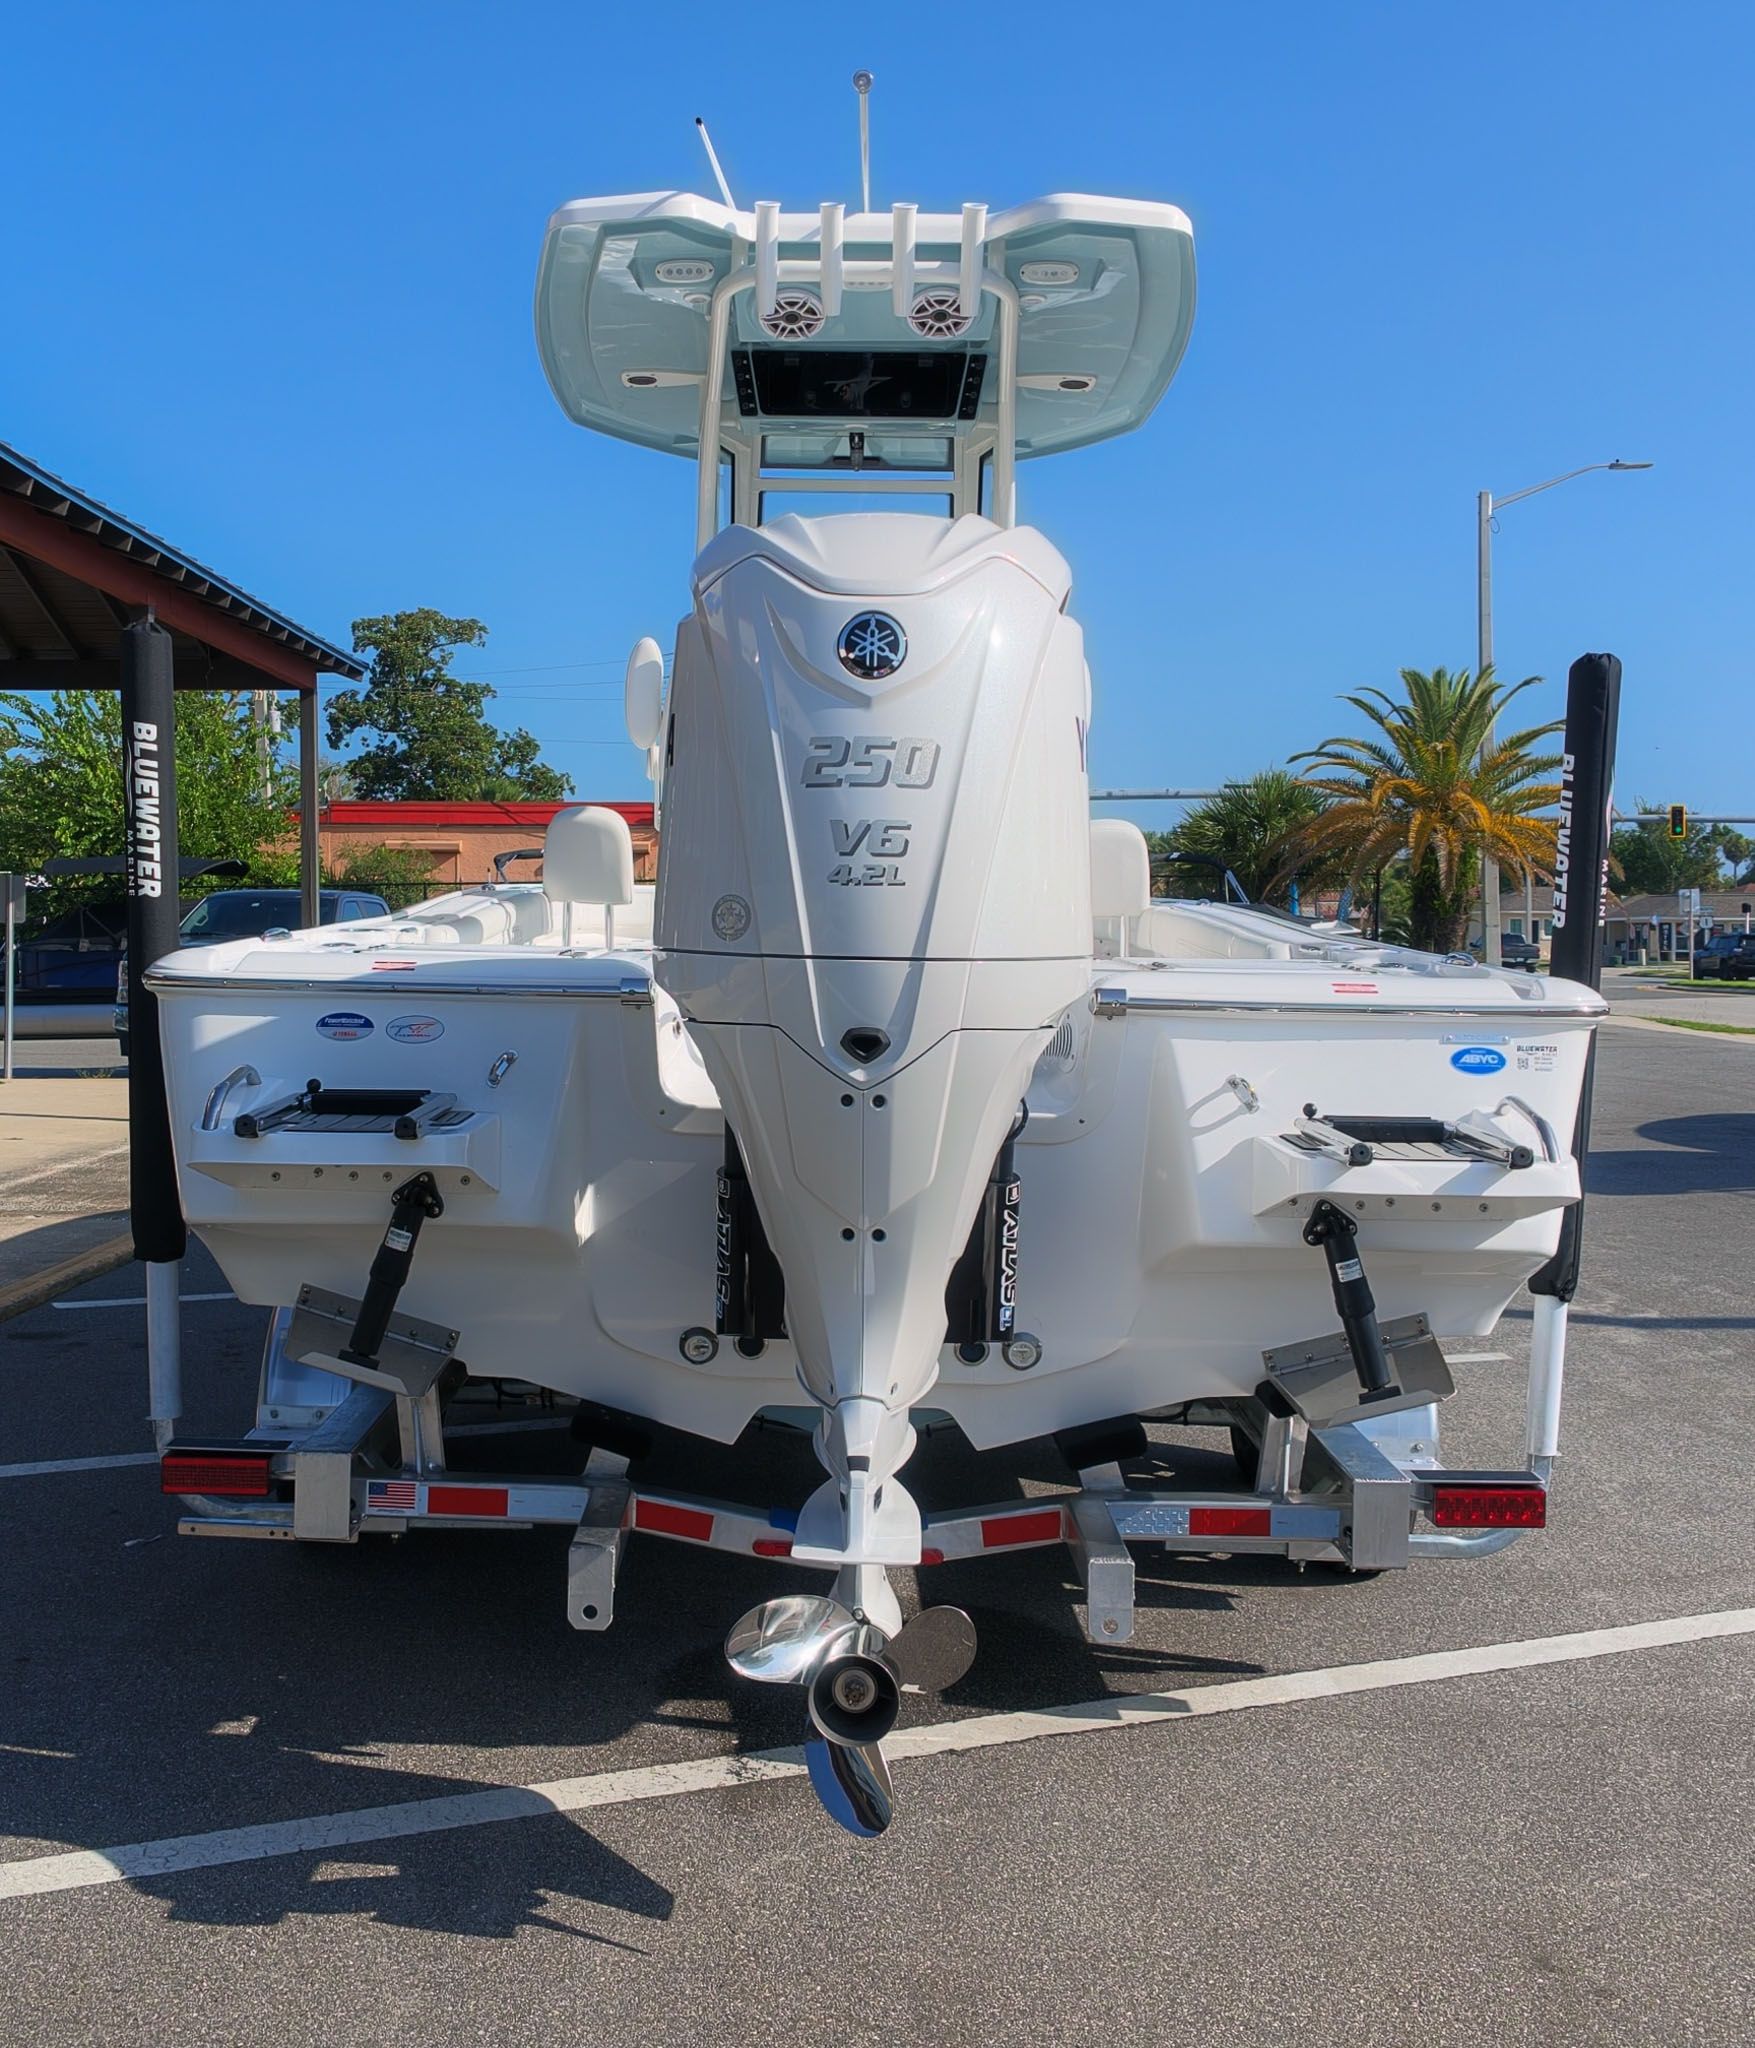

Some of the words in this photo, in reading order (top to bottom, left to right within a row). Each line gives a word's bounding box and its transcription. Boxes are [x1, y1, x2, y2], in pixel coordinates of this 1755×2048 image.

[801, 736, 941, 790] 250
[133, 721, 162, 898] BLUEWATER
[829, 819, 912, 857] V6
[127, 830, 135, 897] MARINE
[826, 864, 906, 886] 4.2L
[1598, 859, 1608, 927] MARINE
[1459, 1054, 1499, 1065] ABYC
[1000, 1210, 1019, 1306] ATLAS
